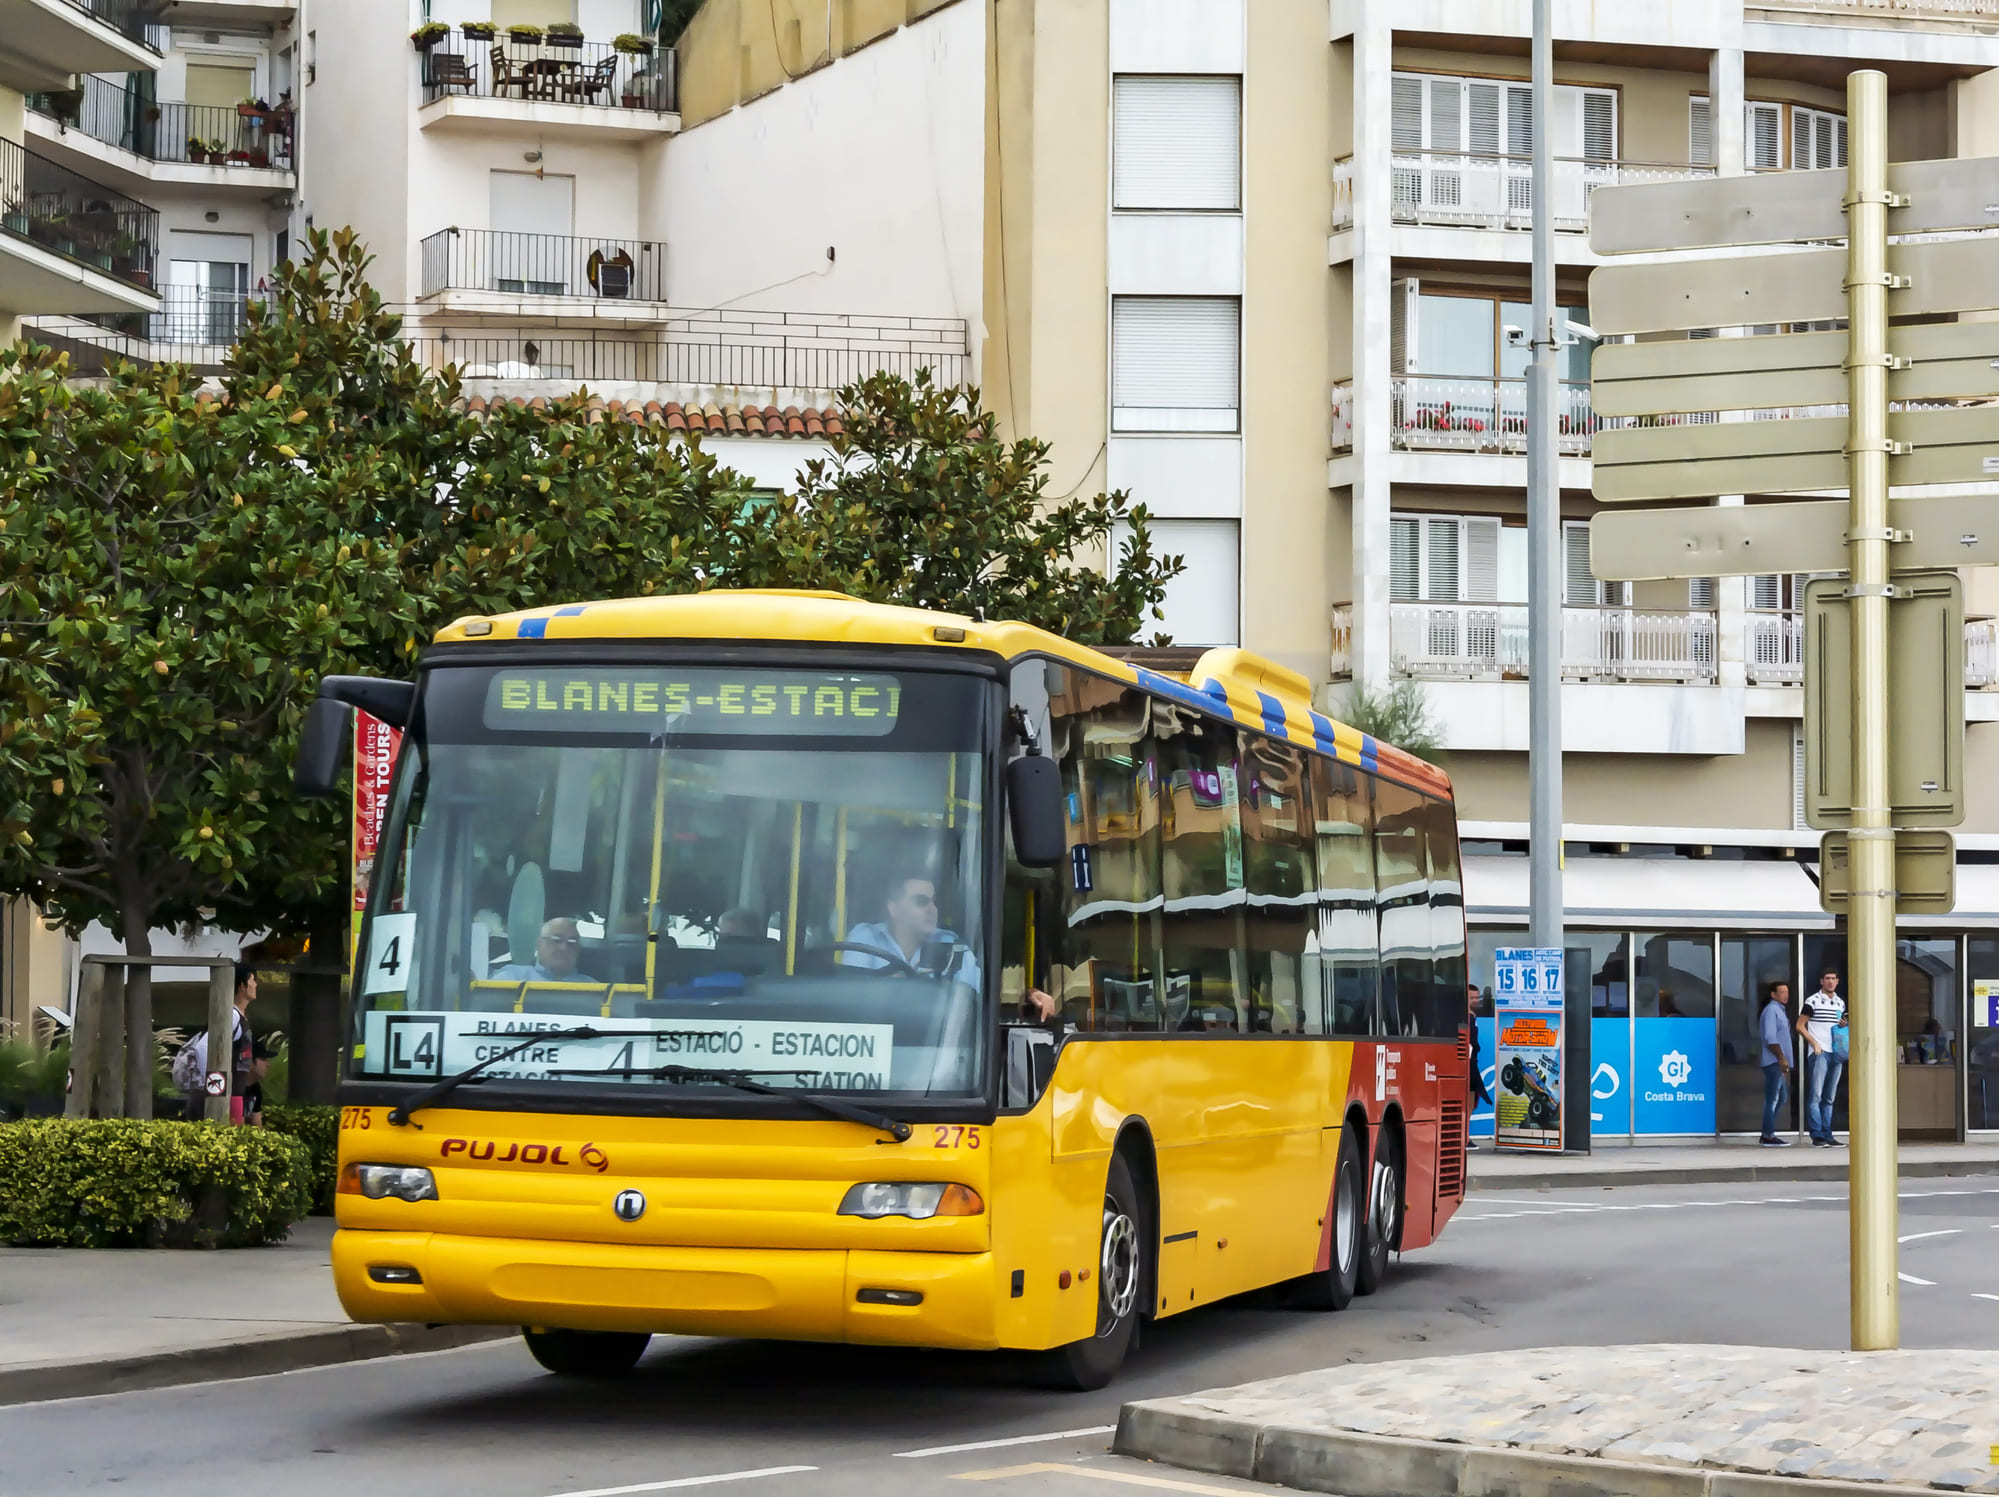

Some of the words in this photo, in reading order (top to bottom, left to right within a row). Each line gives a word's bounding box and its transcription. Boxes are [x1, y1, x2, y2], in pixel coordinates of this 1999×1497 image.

[376, 722, 391, 788] TOURS
[379, 935, 400, 976] 4
[1496, 950, 1533, 961] BLANES
[1498, 968, 1514, 989] 15
[1521, 968, 1537, 990] 16
[1545, 968, 1559, 990] 17
[392, 1031, 435, 1070] L4
[655, 1026, 743, 1053] ESTACIÓ
[772, 1032, 875, 1058] ESTACION
[795, 1072, 883, 1090] STATION
[1645, 1091, 1674, 1101] Costa
[1676, 1091, 1705, 1101] Brava
[341, 1108, 371, 1130] 275
[934, 1125, 980, 1149] 275
[441, 1138, 569, 1165] PUJOL
